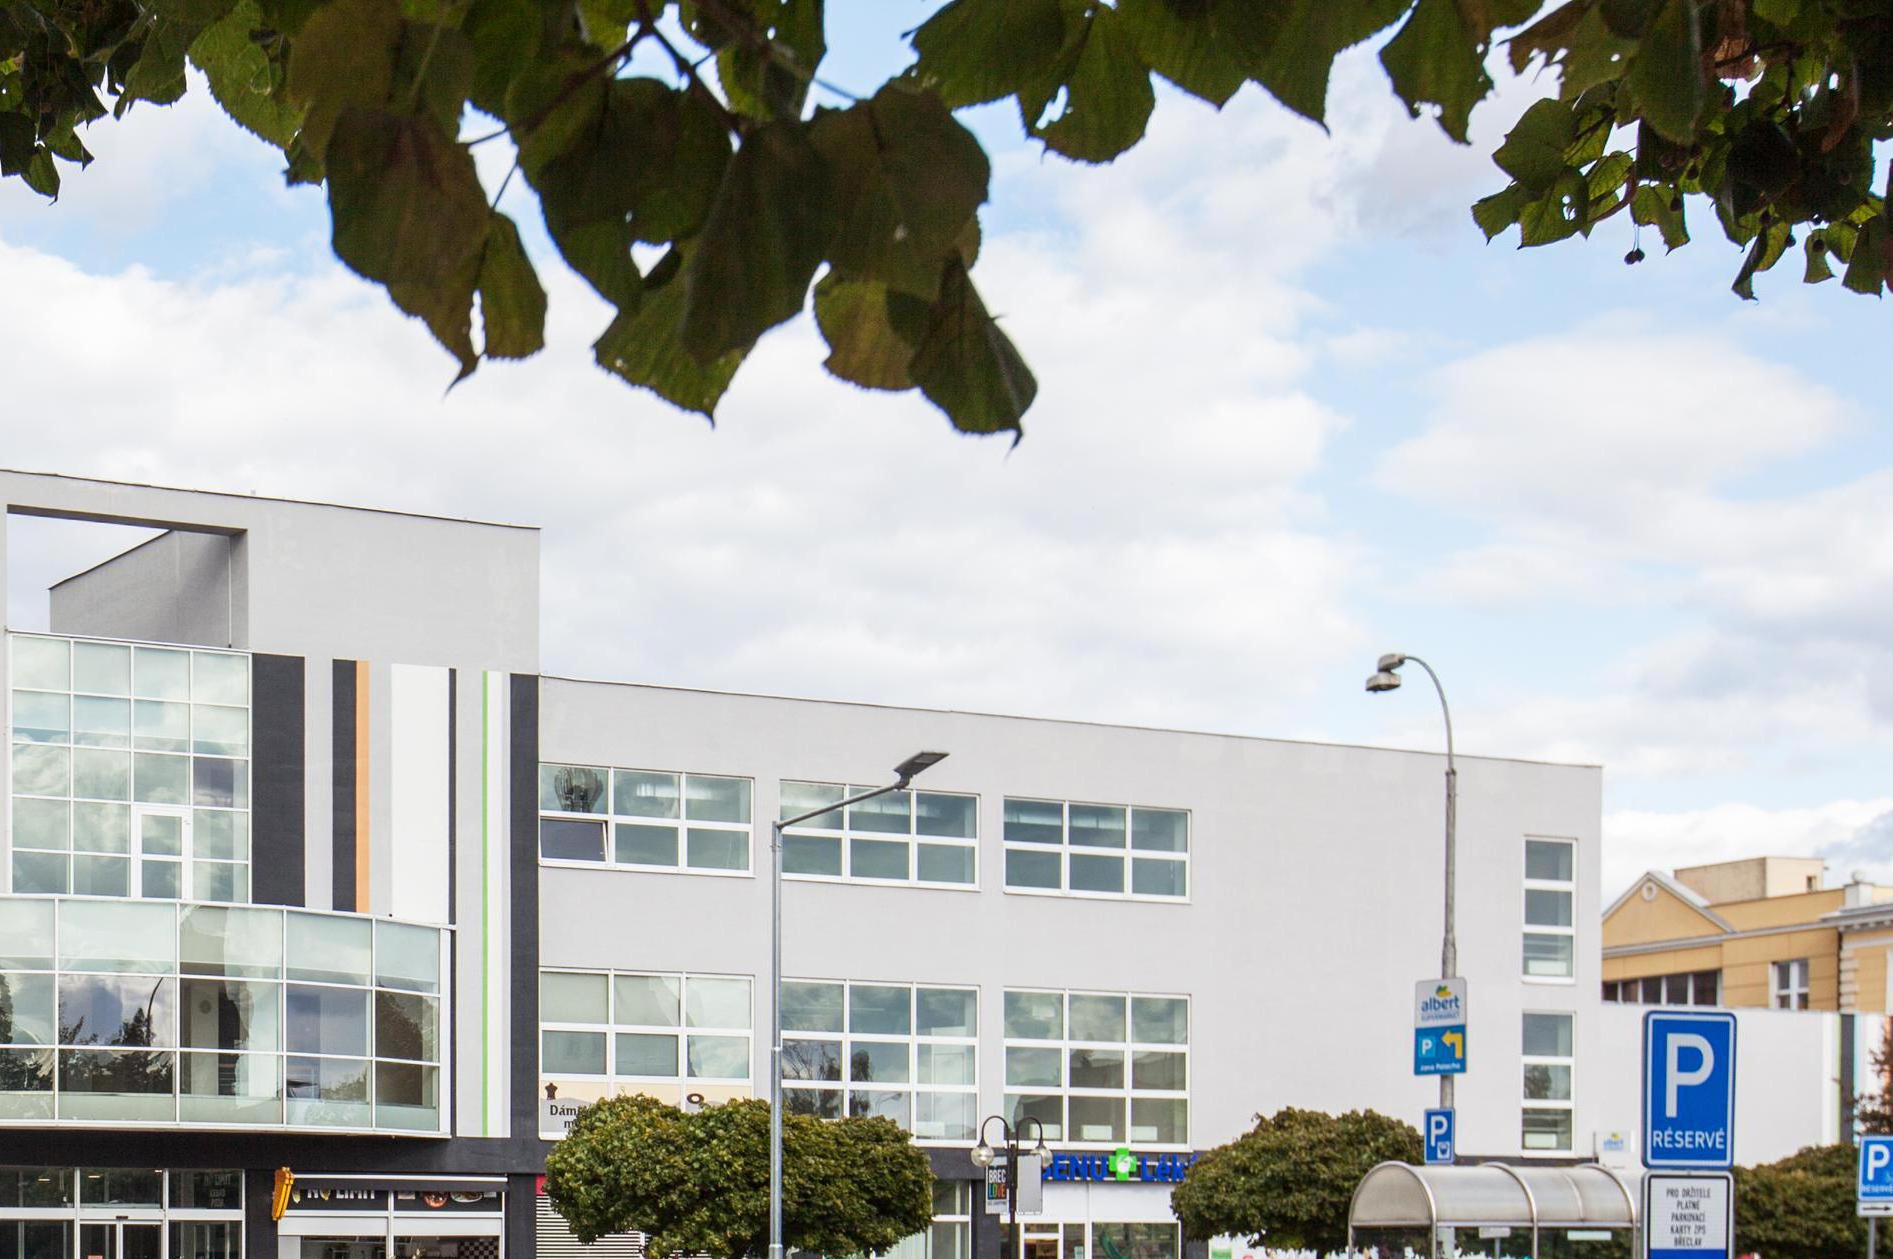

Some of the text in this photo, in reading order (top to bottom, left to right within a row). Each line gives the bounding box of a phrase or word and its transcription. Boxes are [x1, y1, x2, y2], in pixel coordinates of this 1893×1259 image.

[1421, 995, 1460, 1012] albert
[1422, 1039, 1432, 1056] P
[1665, 1033, 1715, 1118] P
[1430, 1115, 1448, 1147] P
[1653, 1126, 1725, 1149] RÉSERVÉ
[1141, 1152, 1197, 1182] Lék
[1868, 1144, 1890, 1181] P
